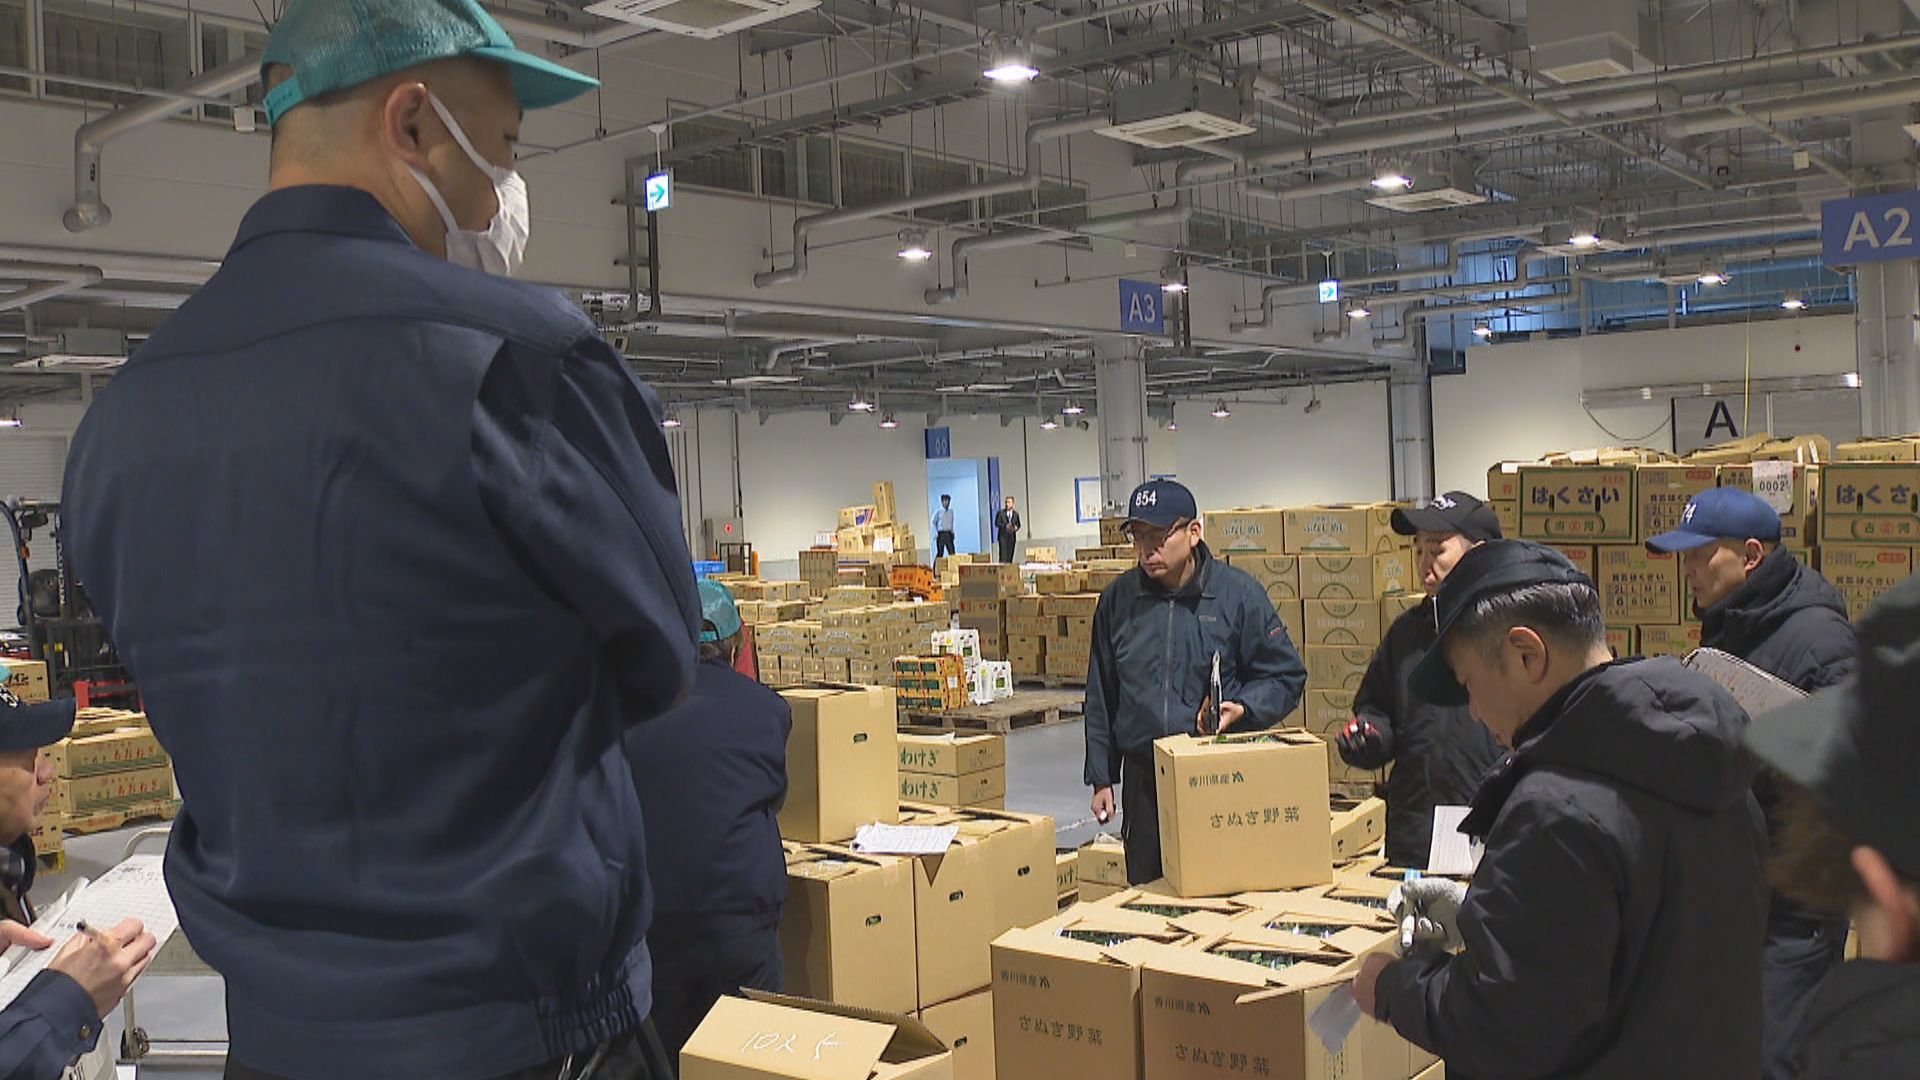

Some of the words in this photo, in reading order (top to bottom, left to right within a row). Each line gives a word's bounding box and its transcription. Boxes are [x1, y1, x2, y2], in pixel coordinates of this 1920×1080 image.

[1843, 207, 1913, 251] A2
[1129, 292, 1156, 323] A3
[1704, 401, 1738, 438] A
[1135, 490, 1157, 506] 854
[1532, 485, 1620, 505] はくさい
[1836, 485, 1920, 504] はくさ
[900, 746, 941, 768] わけぎ
[901, 778, 943, 799] わけぎ
[1210, 805, 1301, 829] さぬき野菜
[1018, 1014, 1103, 1046] さぬき野菜
[1174, 1043, 1271, 1077] さぬき野菜
